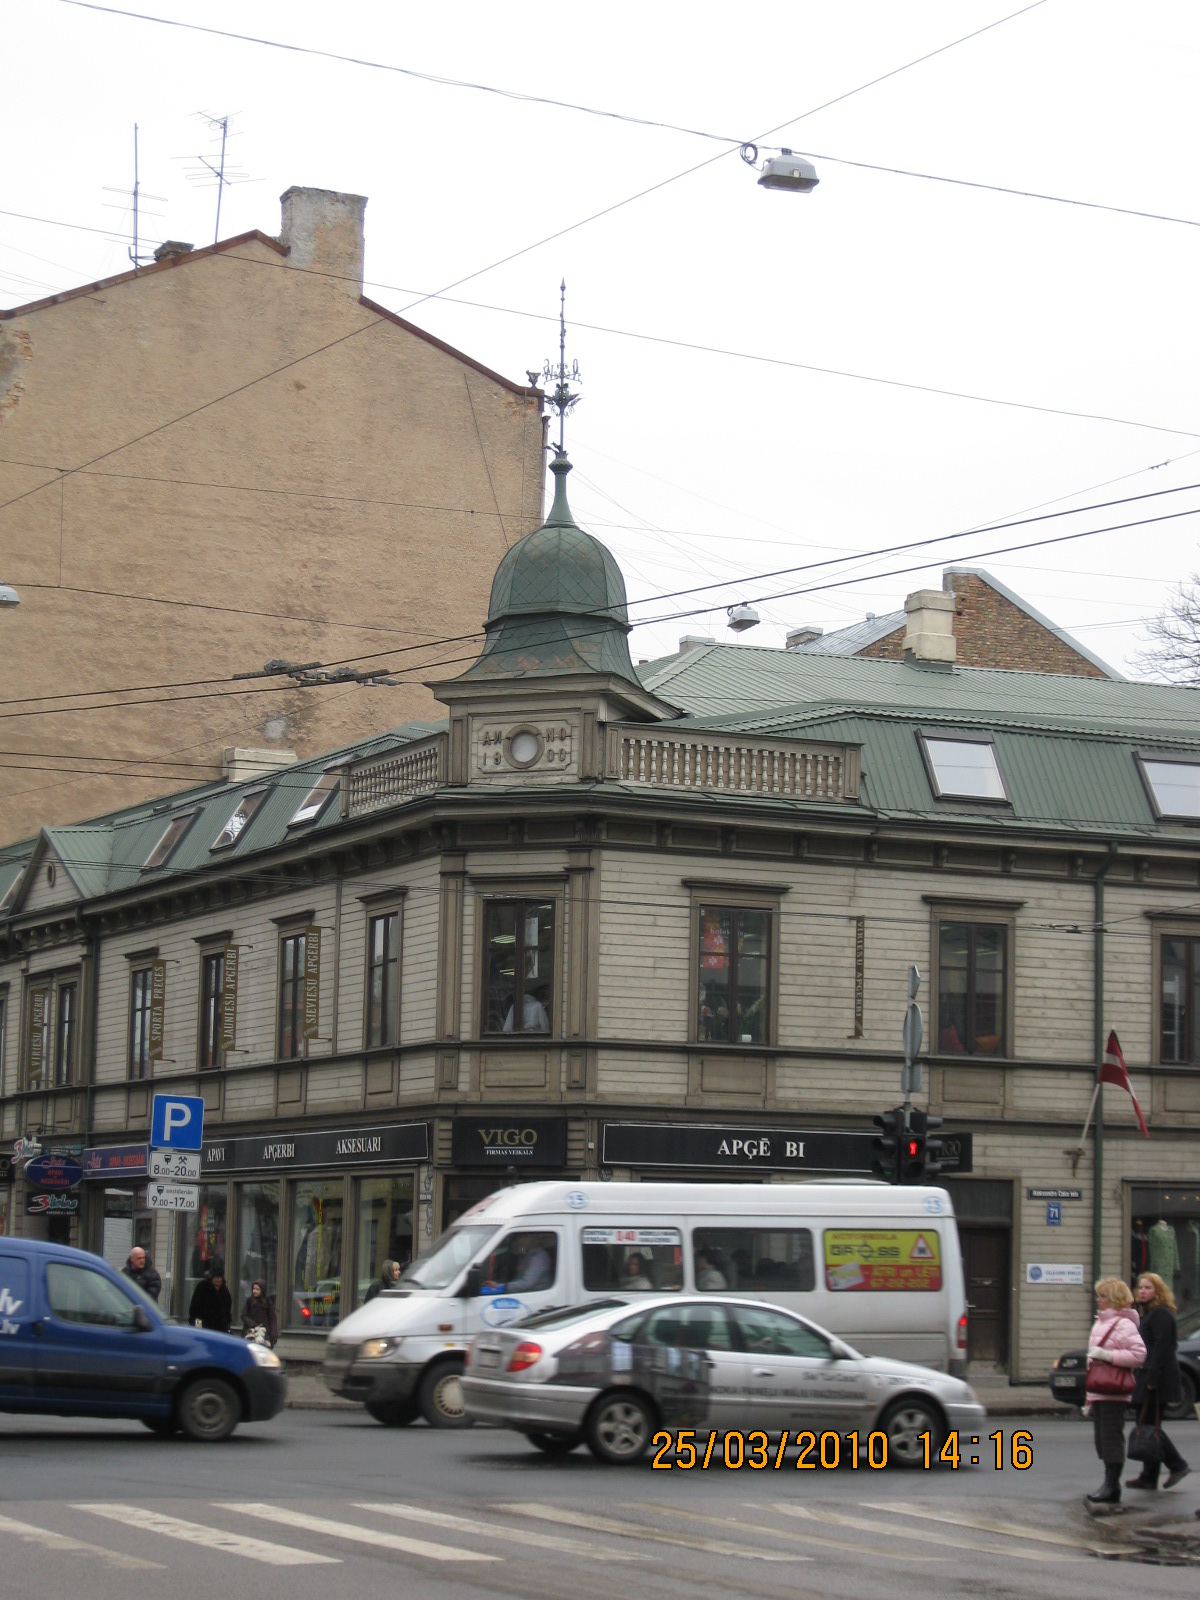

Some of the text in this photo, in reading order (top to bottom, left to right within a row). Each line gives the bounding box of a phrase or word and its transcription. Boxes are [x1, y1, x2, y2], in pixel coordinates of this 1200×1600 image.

[153, 966, 164, 999] PRECES
[152, 1006, 163, 1041] SPORTA
[163, 1102, 192, 1142] P
[477, 1128, 538, 1146] VIGO
[717, 1137, 805, 1160] APĢĒ BI
[206, 1147, 225, 1162] APAVI
[335, 1136, 381, 1155] AKSESUARI
[153, 1164, 197, 1178] 8.00-20.00
[151, 1196, 195, 1208] 9.00-17.00
[1049, 1207, 1059, 1218] 71
